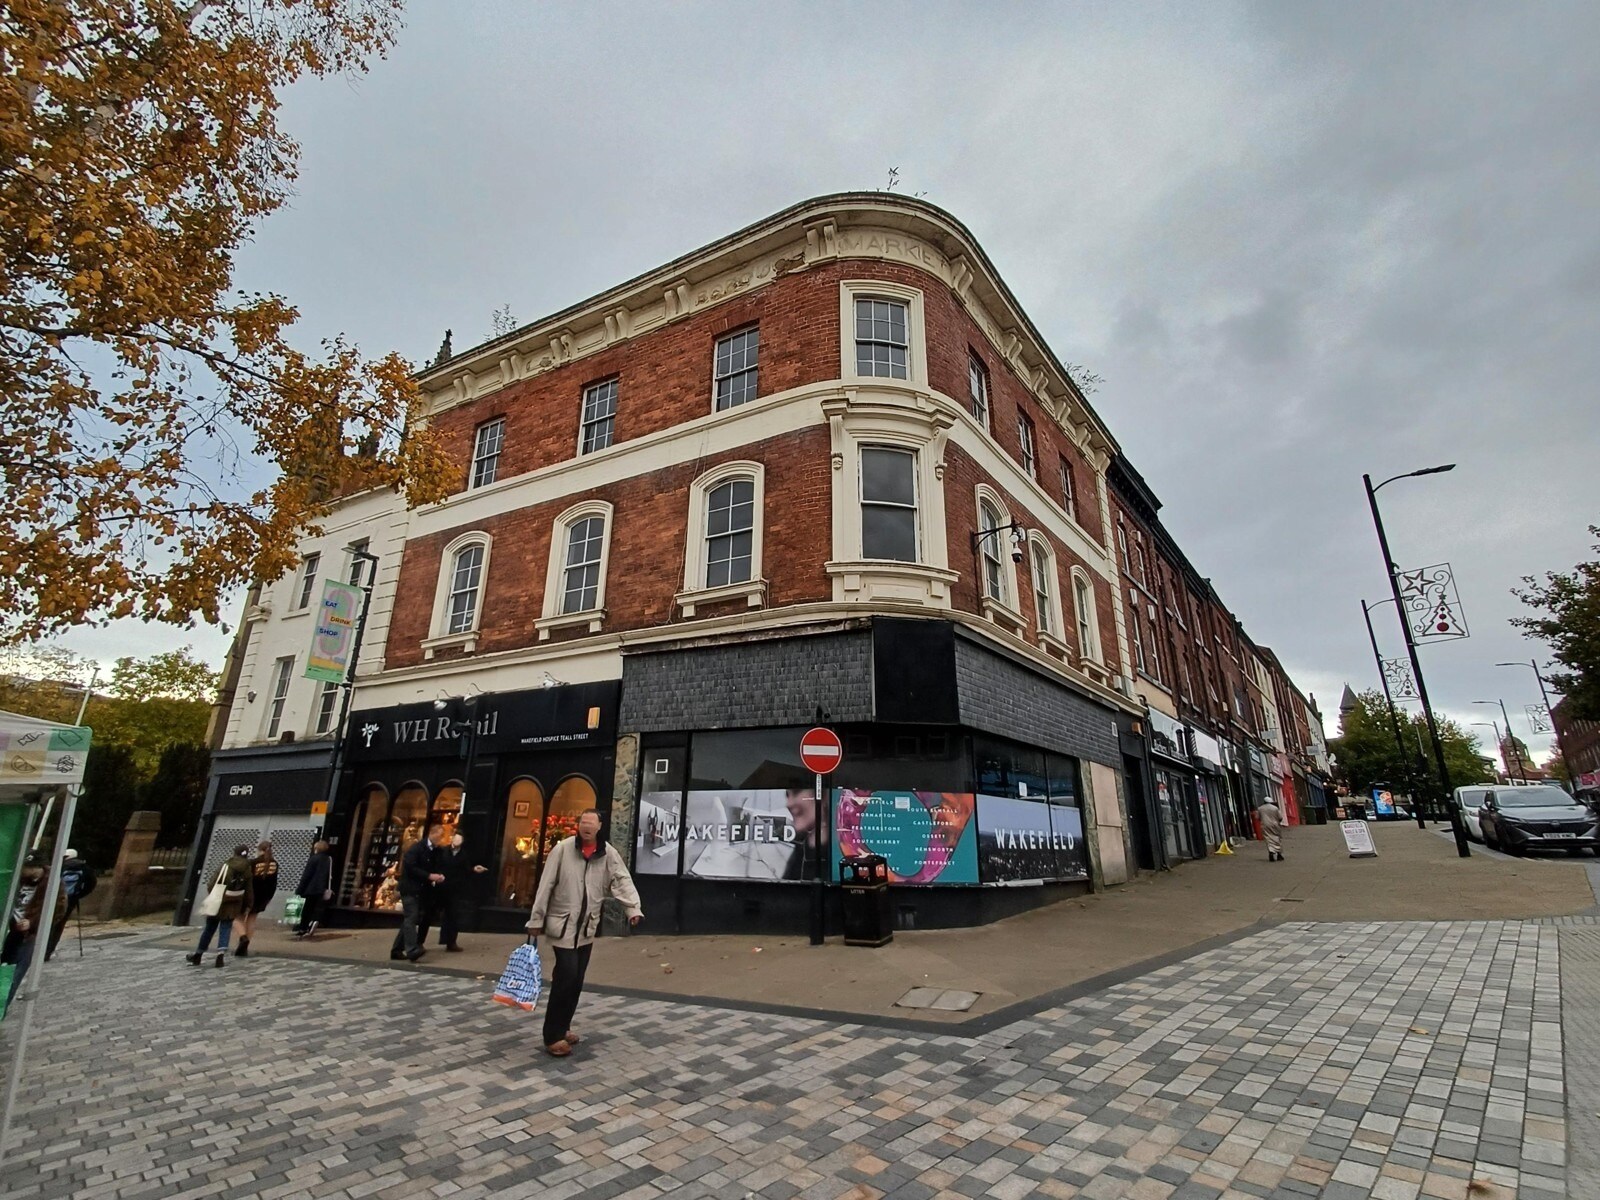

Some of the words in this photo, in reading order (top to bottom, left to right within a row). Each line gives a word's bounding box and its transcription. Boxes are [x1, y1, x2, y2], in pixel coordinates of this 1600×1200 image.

[325, 600, 339, 610] EAT
[330, 616, 351, 626] DRINK
[319, 628, 339, 637] SHOP
[394, 718, 431, 744] WH
[521, 736, 542, 744] WAKEFIELD
[543, 735, 559, 743] HOSPICE
[229, 785, 253, 796] GHIA
[665, 824, 796, 843] WAKEFIELD
[995, 828, 1074, 851] WAKEFIELD
